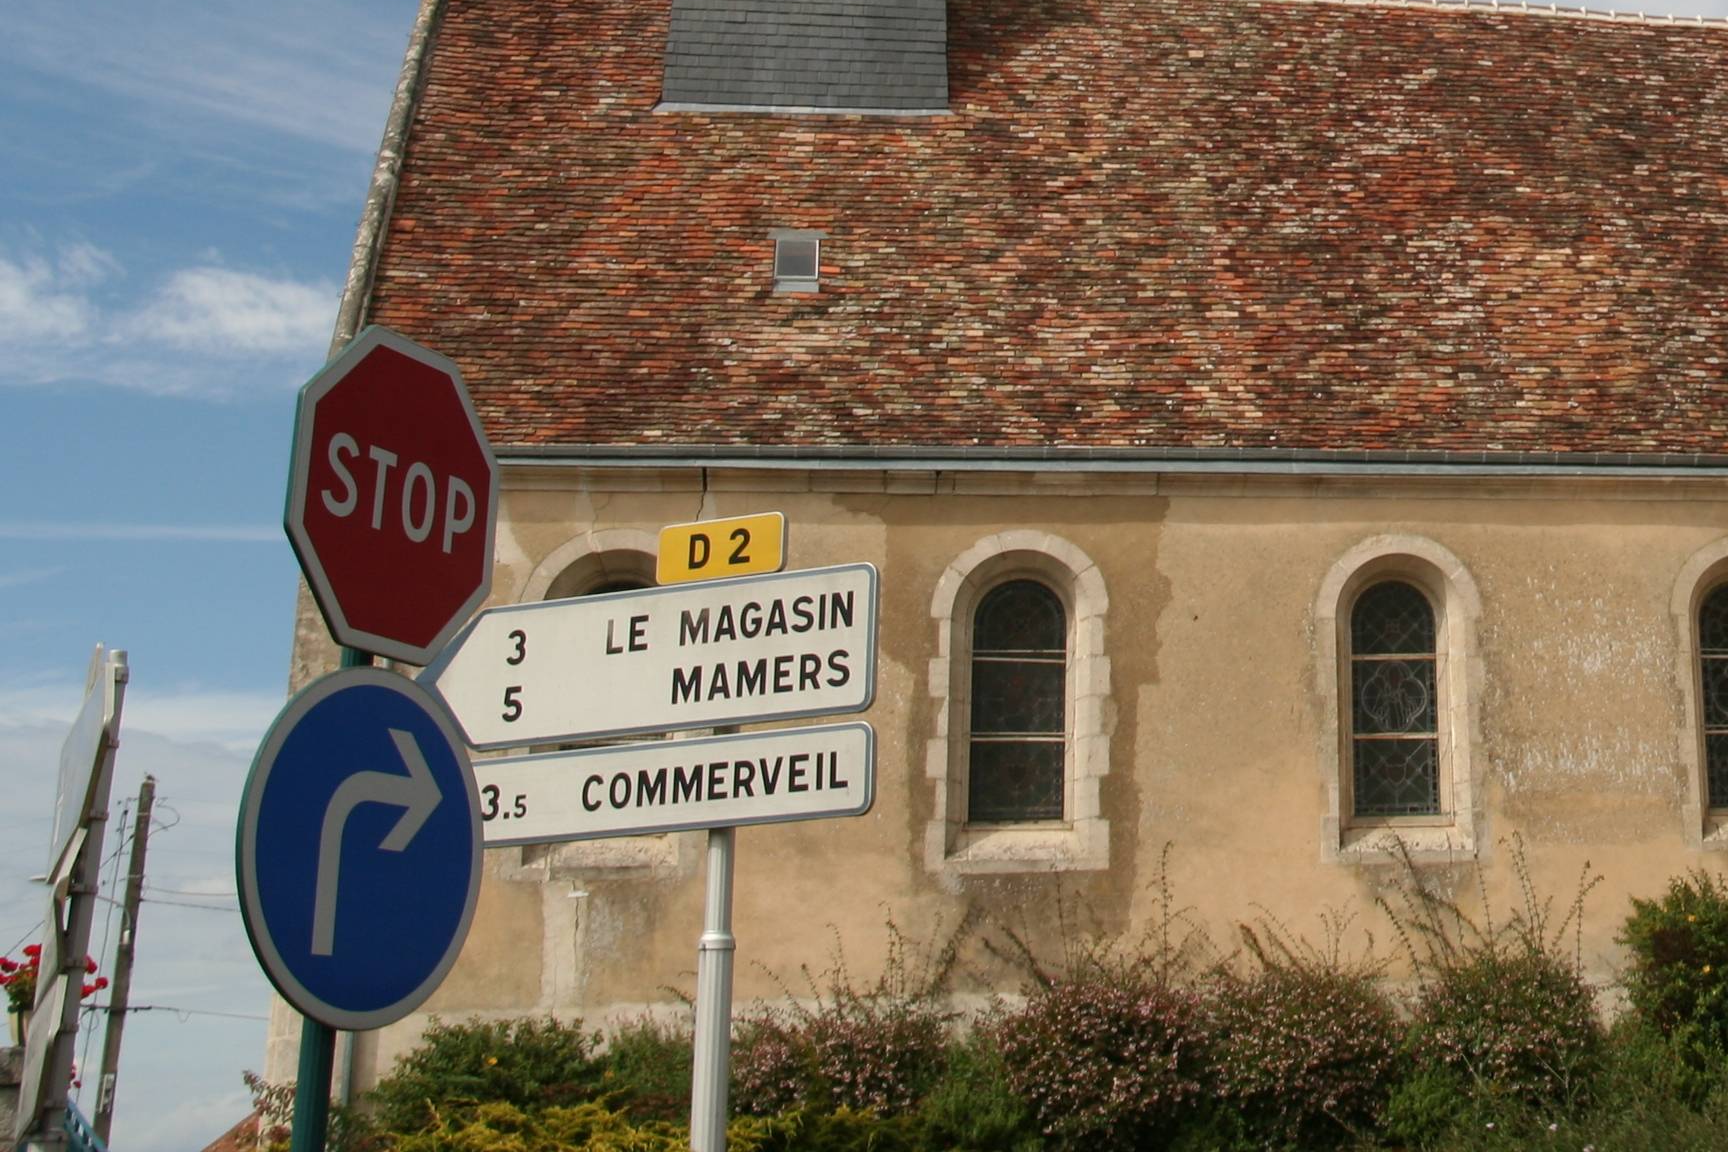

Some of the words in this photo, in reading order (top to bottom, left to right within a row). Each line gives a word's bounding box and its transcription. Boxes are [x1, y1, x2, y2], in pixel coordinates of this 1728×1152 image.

[321, 432, 476, 554] STOP
[688, 533, 711, 570] D
[728, 528, 751, 565] 2
[506, 629, 527, 666] 3
[605, 614, 650, 655] LE
[679, 590, 854, 647] MAGASIN
[502, 685, 523, 723] 5
[671, 649, 851, 705] MAMERS
[481, 784, 527, 822] 3.5
[581, 751, 849, 812] COMMERVEIL
